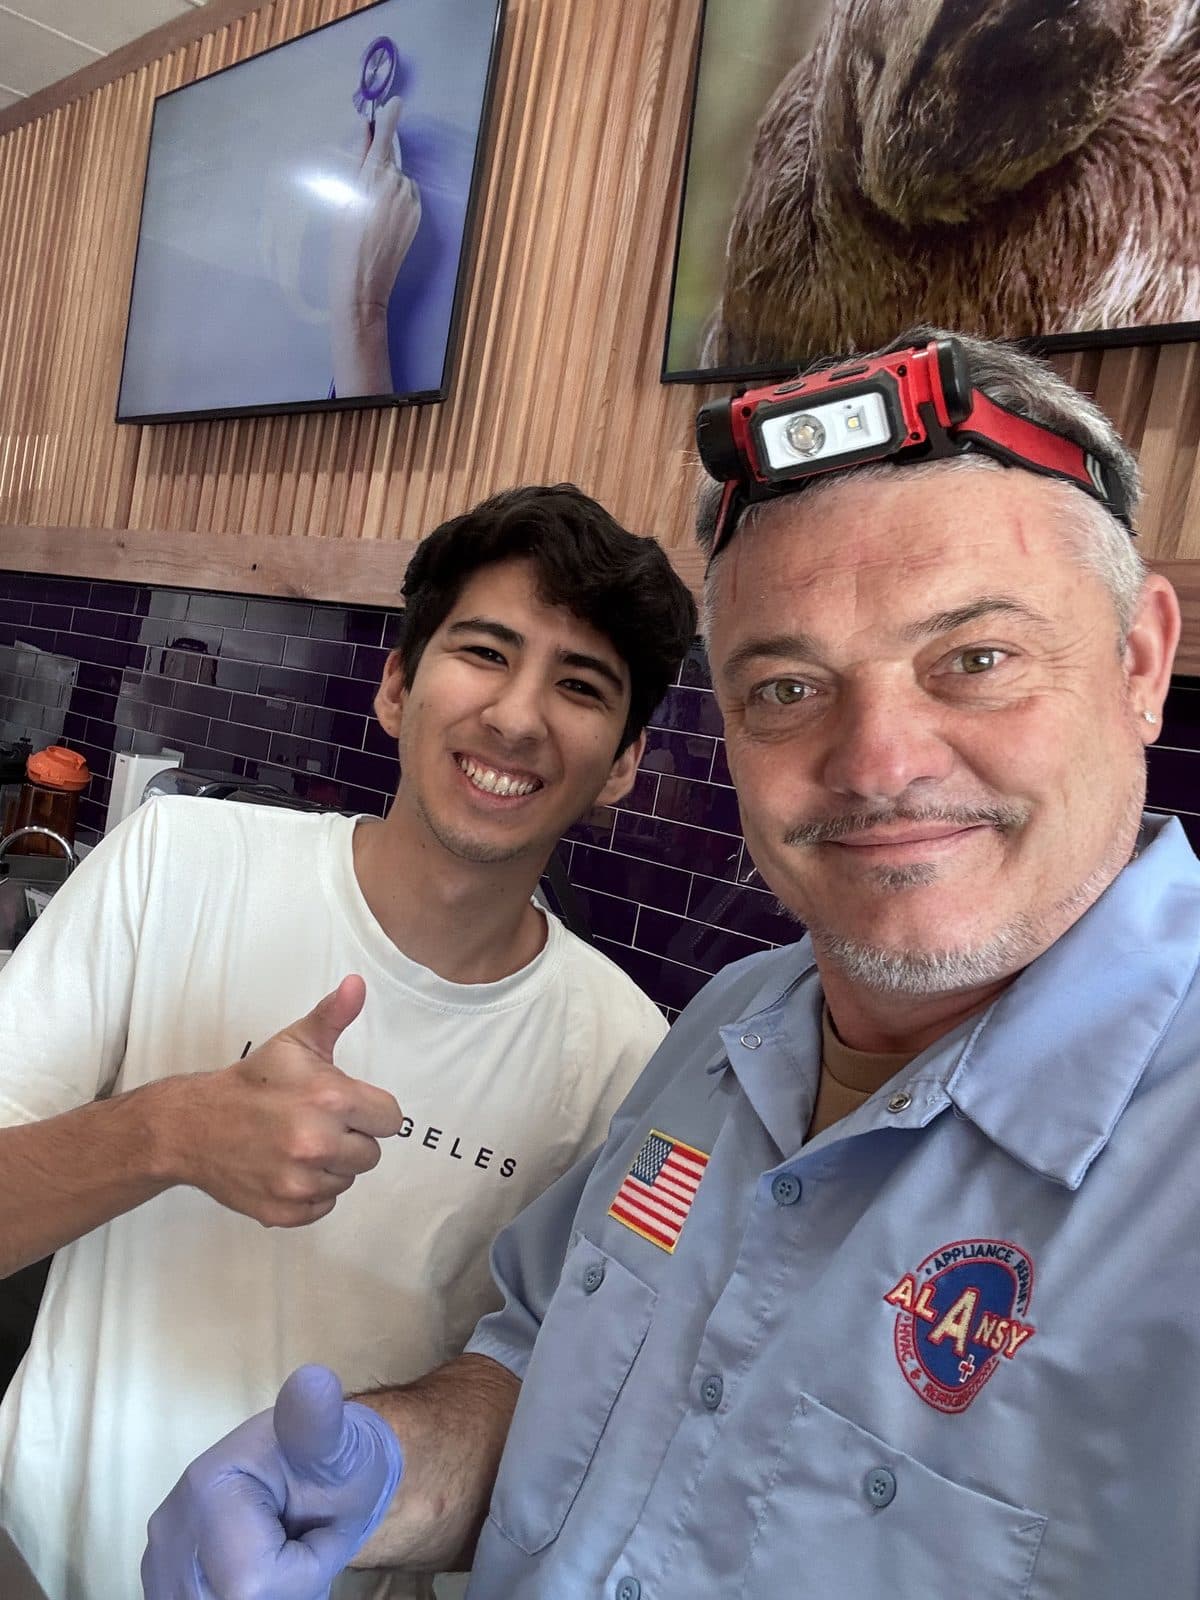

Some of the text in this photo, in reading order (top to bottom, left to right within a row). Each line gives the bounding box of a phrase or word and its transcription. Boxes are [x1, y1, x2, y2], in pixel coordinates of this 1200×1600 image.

[397, 1116, 517, 1178] GELES
[934, 1244, 1030, 1305] APPLIANCE REPAIR
[899, 1323, 915, 1363] HVAC
